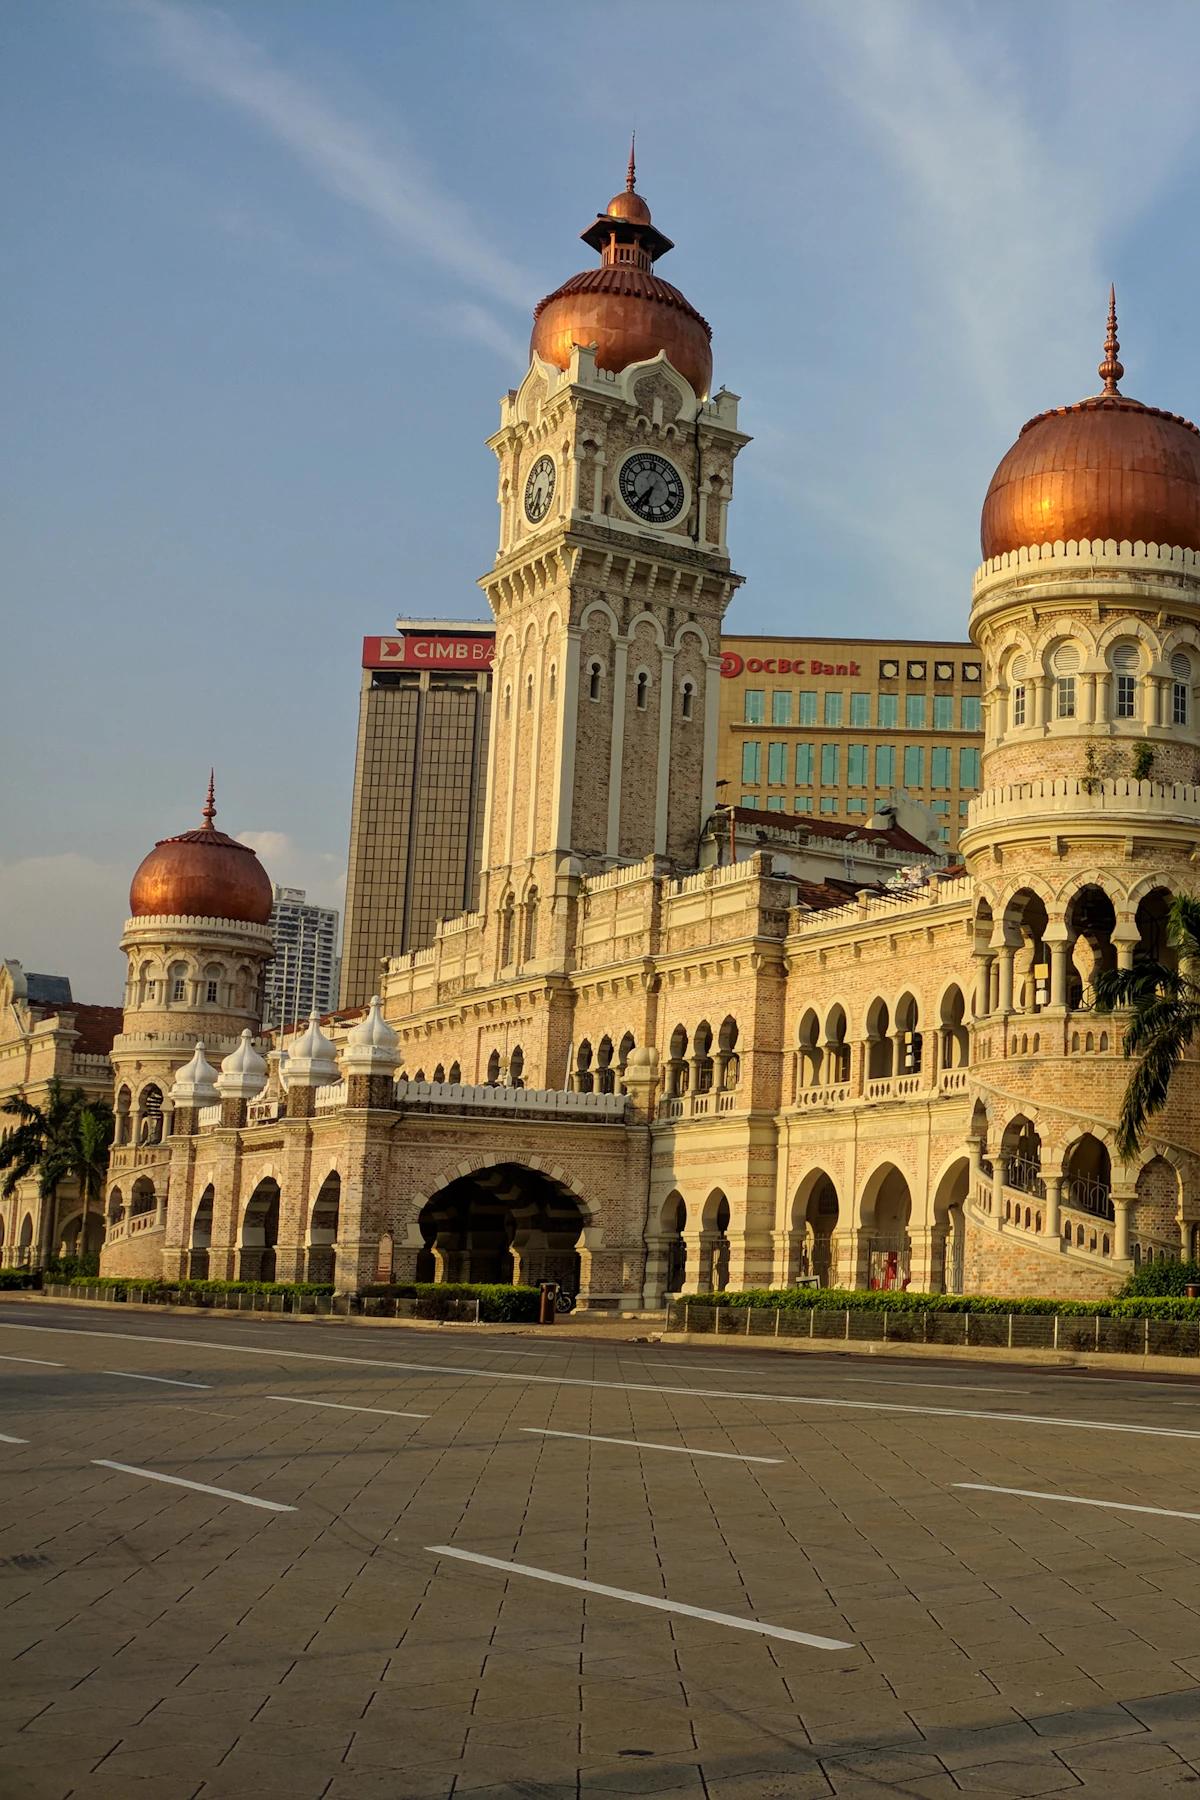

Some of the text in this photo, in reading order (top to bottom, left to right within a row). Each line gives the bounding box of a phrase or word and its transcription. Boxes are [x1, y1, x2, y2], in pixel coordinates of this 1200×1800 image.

[413, 642, 468, 658] CIMB
[746, 658, 861, 676] OCBC Bank
